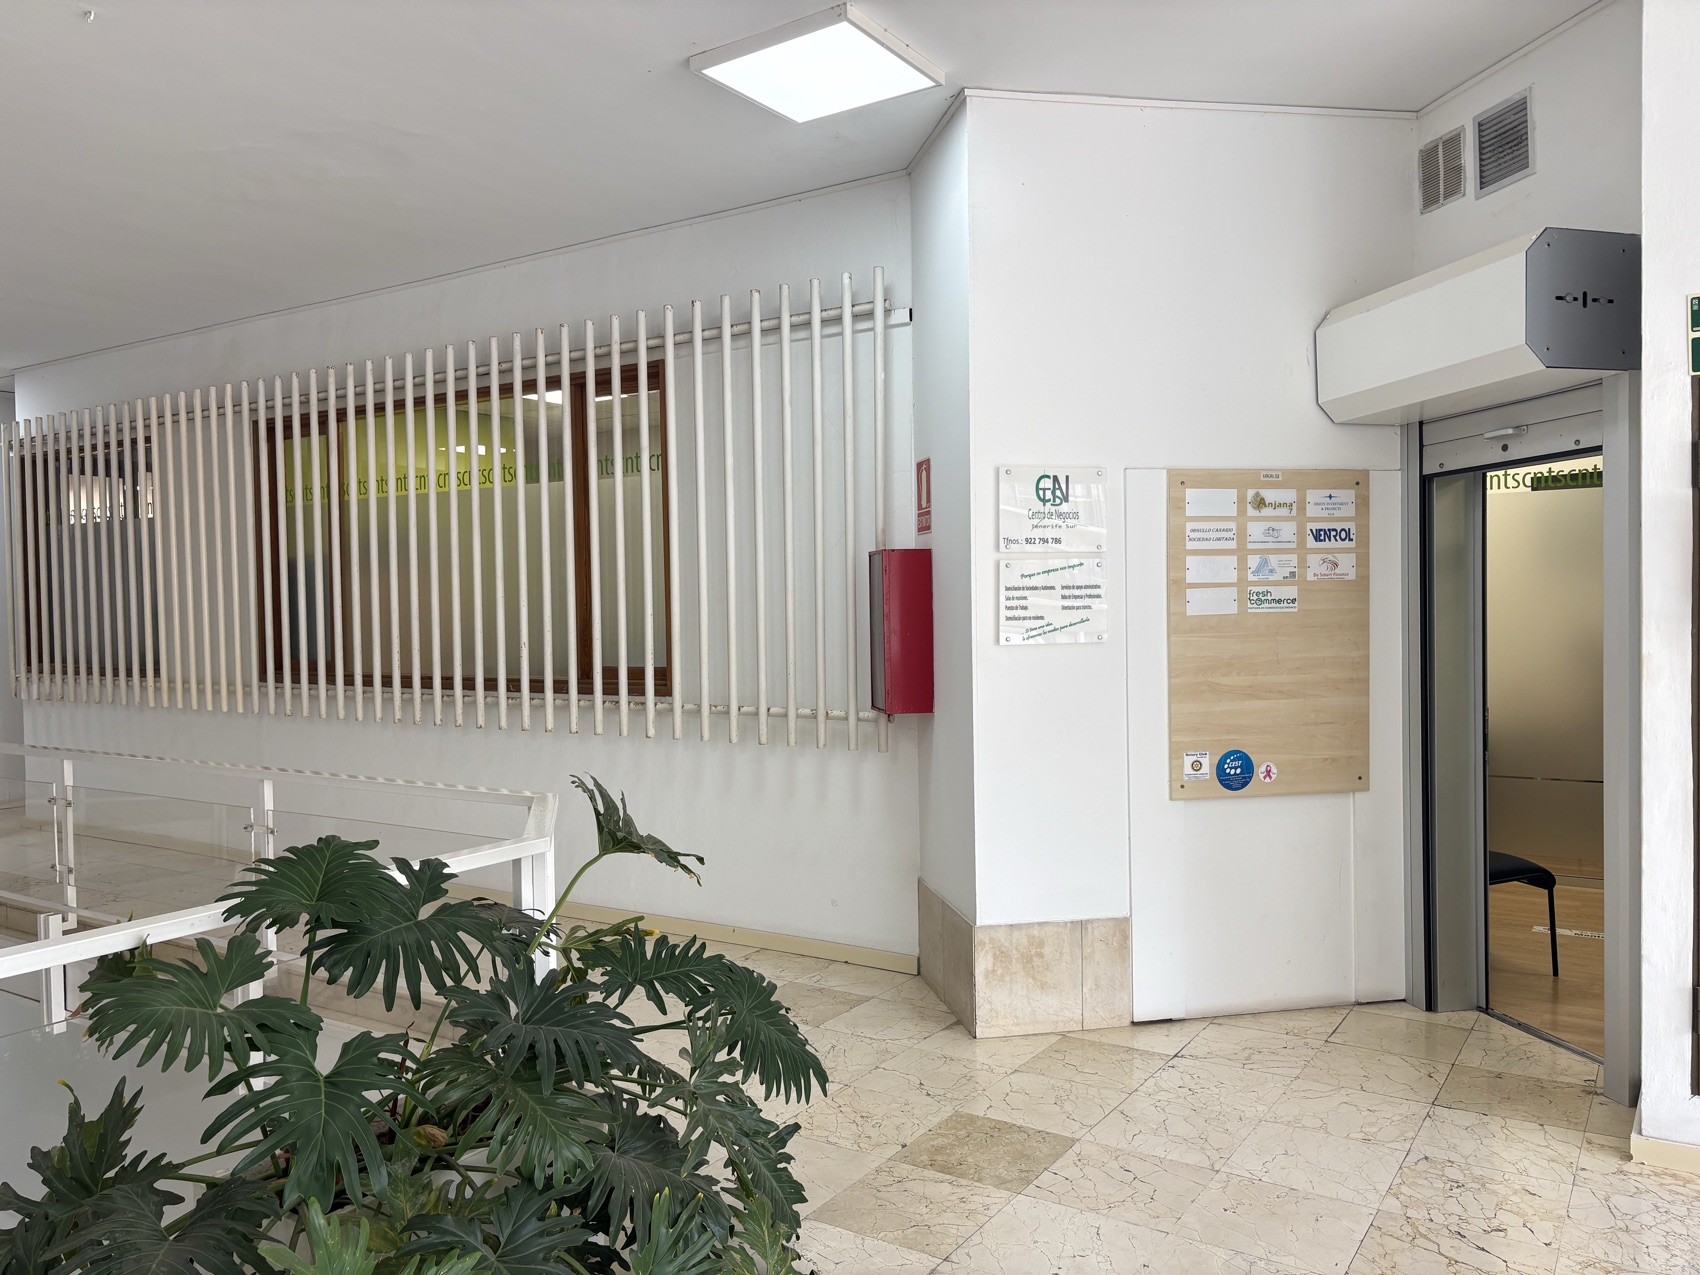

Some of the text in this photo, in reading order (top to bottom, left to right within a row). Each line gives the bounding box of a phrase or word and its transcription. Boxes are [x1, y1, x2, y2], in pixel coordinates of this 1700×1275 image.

[1489, 463, 1601, 491] ntscntscnt
[1257, 497, 1294, 510] Anjana
[1027, 508, 1080, 523] Centro de Negocios
[1031, 523, 1063, 531] Tenerife
[1309, 527, 1354, 543] VENROL
[1024, 537, 1037, 545] 922
[1038, 537, 1050, 545] 794
[1050, 537, 1062, 545] 786
[1248, 589, 1272, 599] fresh
[1248, 598, 1297, 606] commerce
